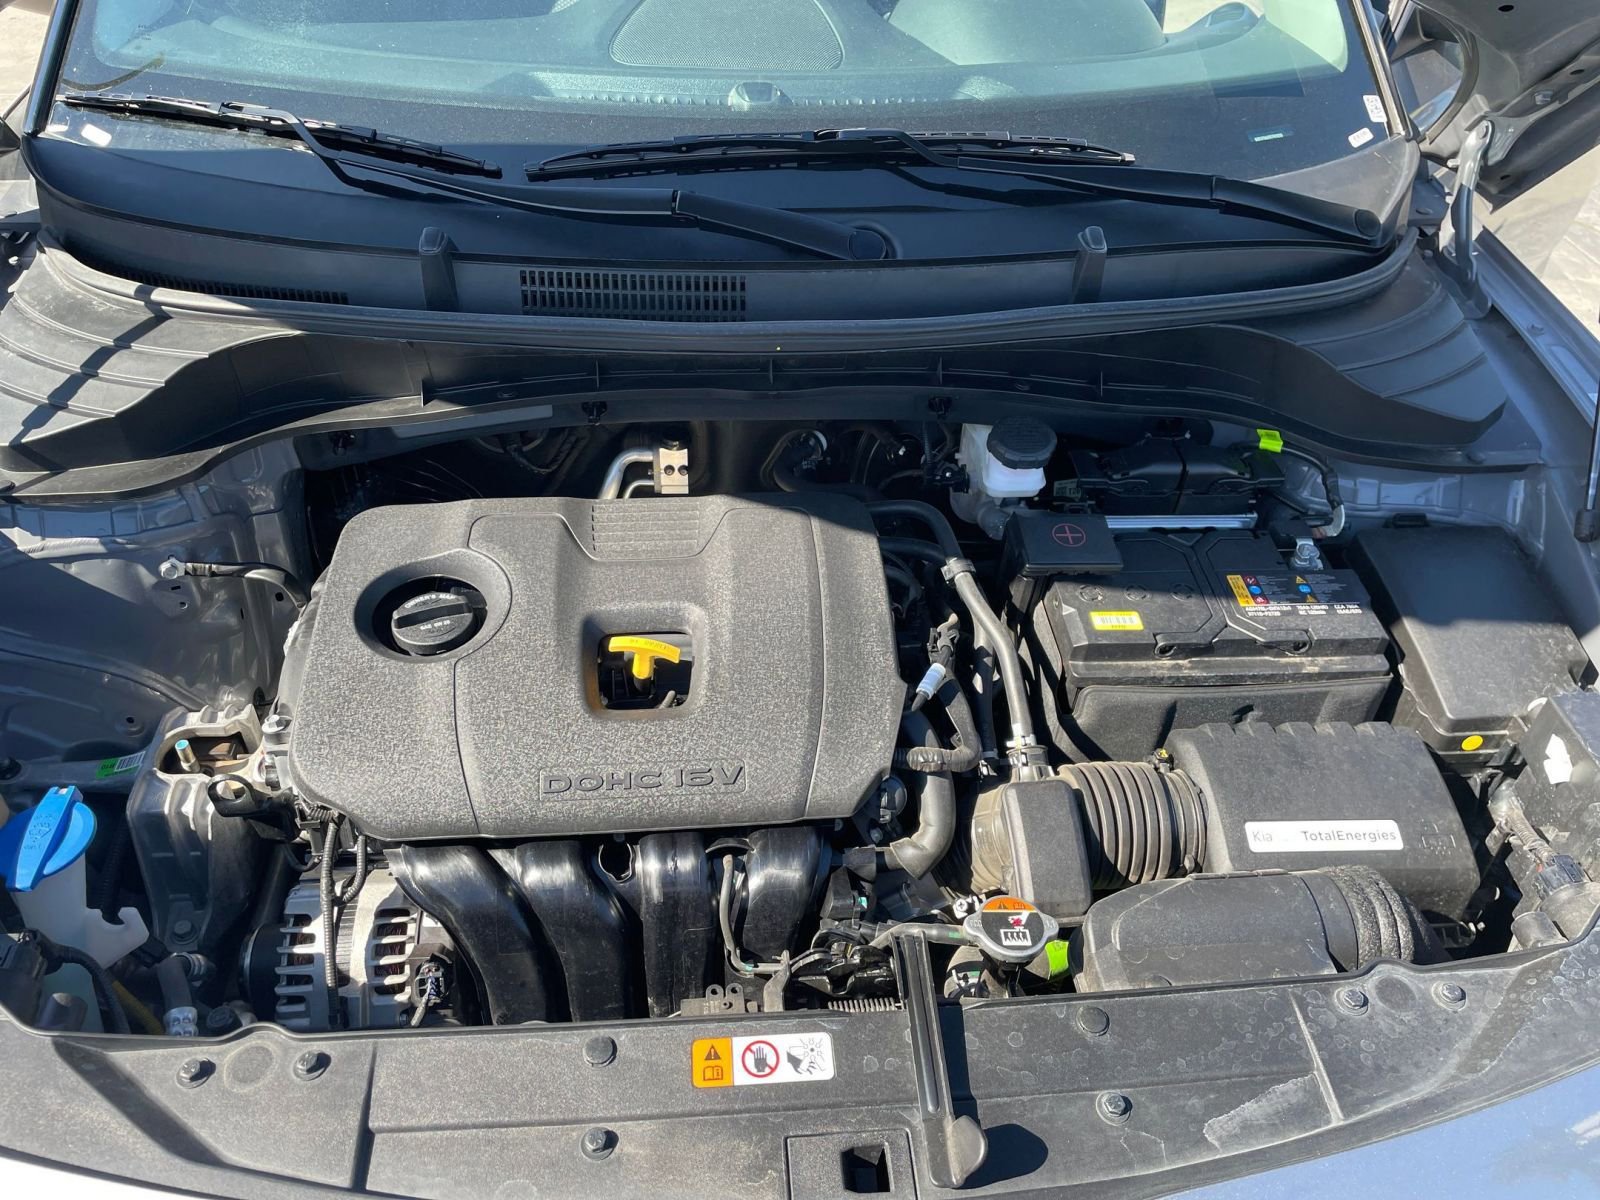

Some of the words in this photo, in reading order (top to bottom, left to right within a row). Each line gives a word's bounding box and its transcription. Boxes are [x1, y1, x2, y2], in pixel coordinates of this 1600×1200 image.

[404, 594, 436, 608] OWNER'S
[542, 770, 662, 794] DOHC
[674, 765, 744, 787] 16V
[1252, 831, 1273, 842] Kia
[1301, 829, 1397, 843] TotalEnergies
